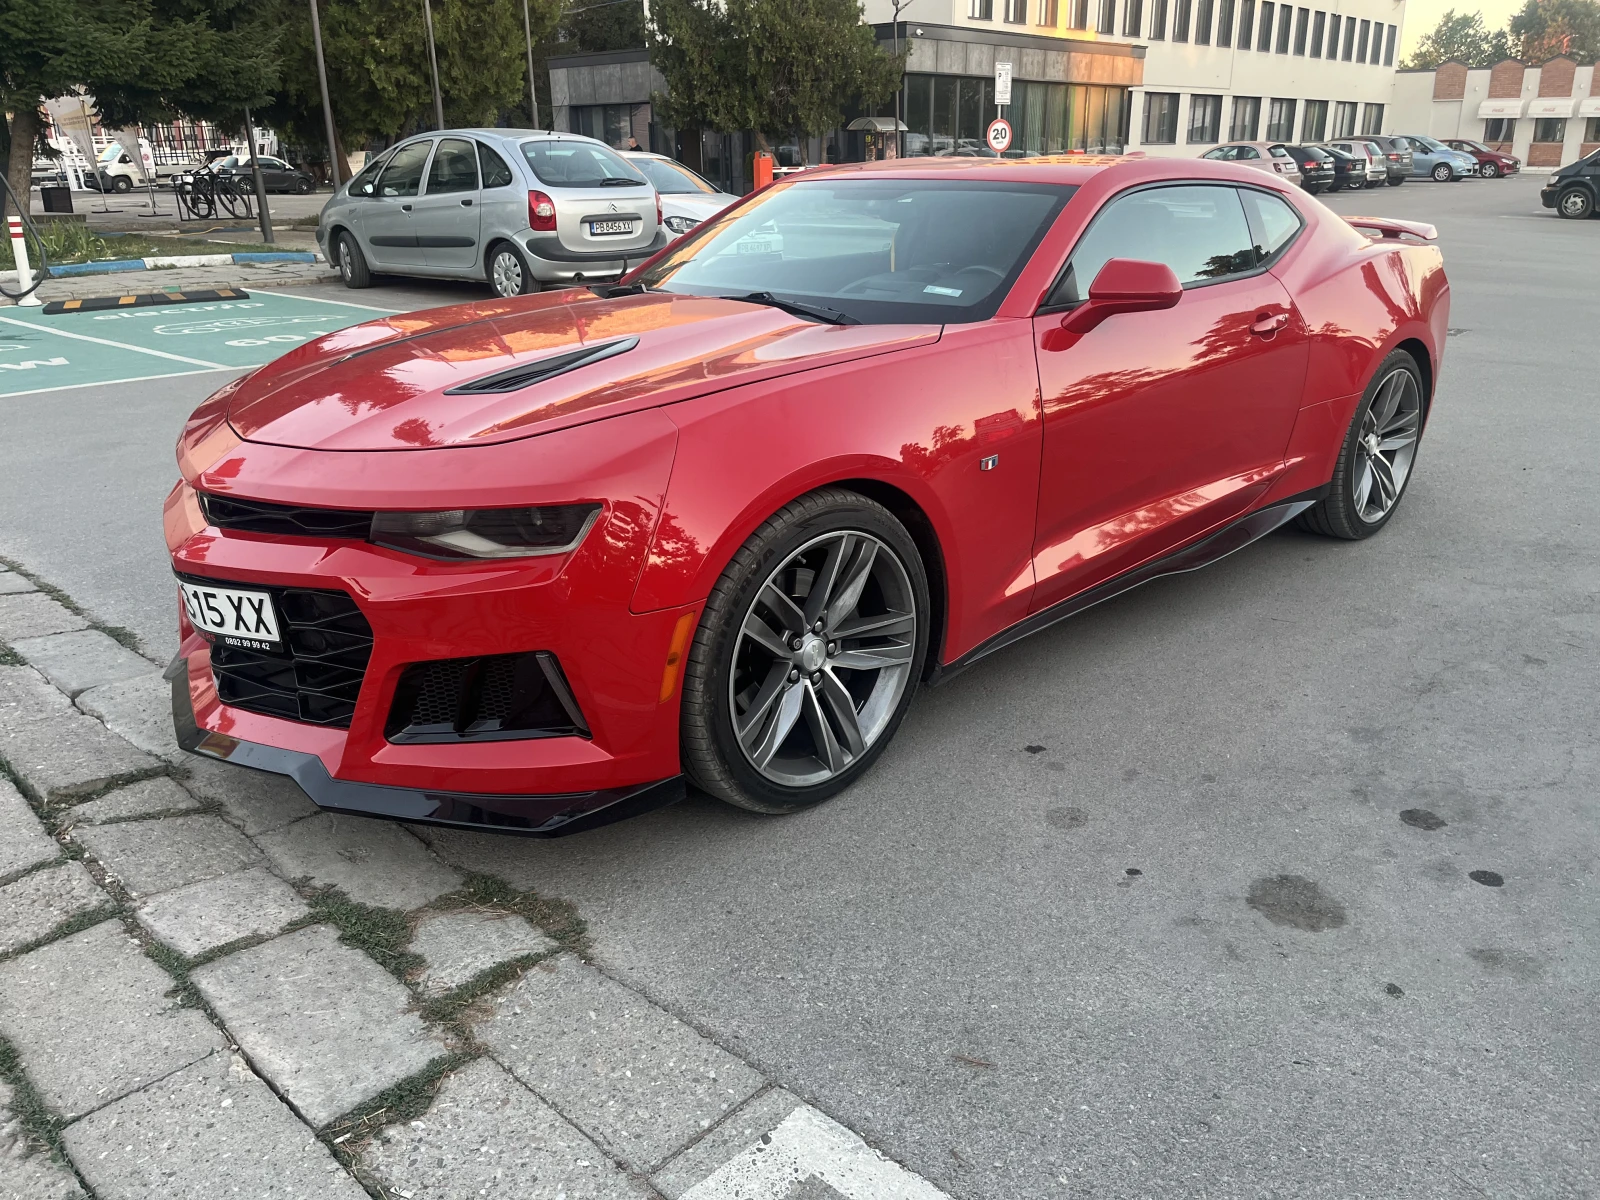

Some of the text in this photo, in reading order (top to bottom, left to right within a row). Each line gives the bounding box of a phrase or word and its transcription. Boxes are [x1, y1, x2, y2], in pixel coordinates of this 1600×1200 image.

[992, 127, 1007, 140] 20
[595, 221, 631, 232] PB 8456 XX
[225, 335, 306, 347] 60
[225, 594, 273, 635] XX
[225, 636, 242, 647] 0892
[242, 639, 251, 648] 99
[252, 641, 261, 649] 99
